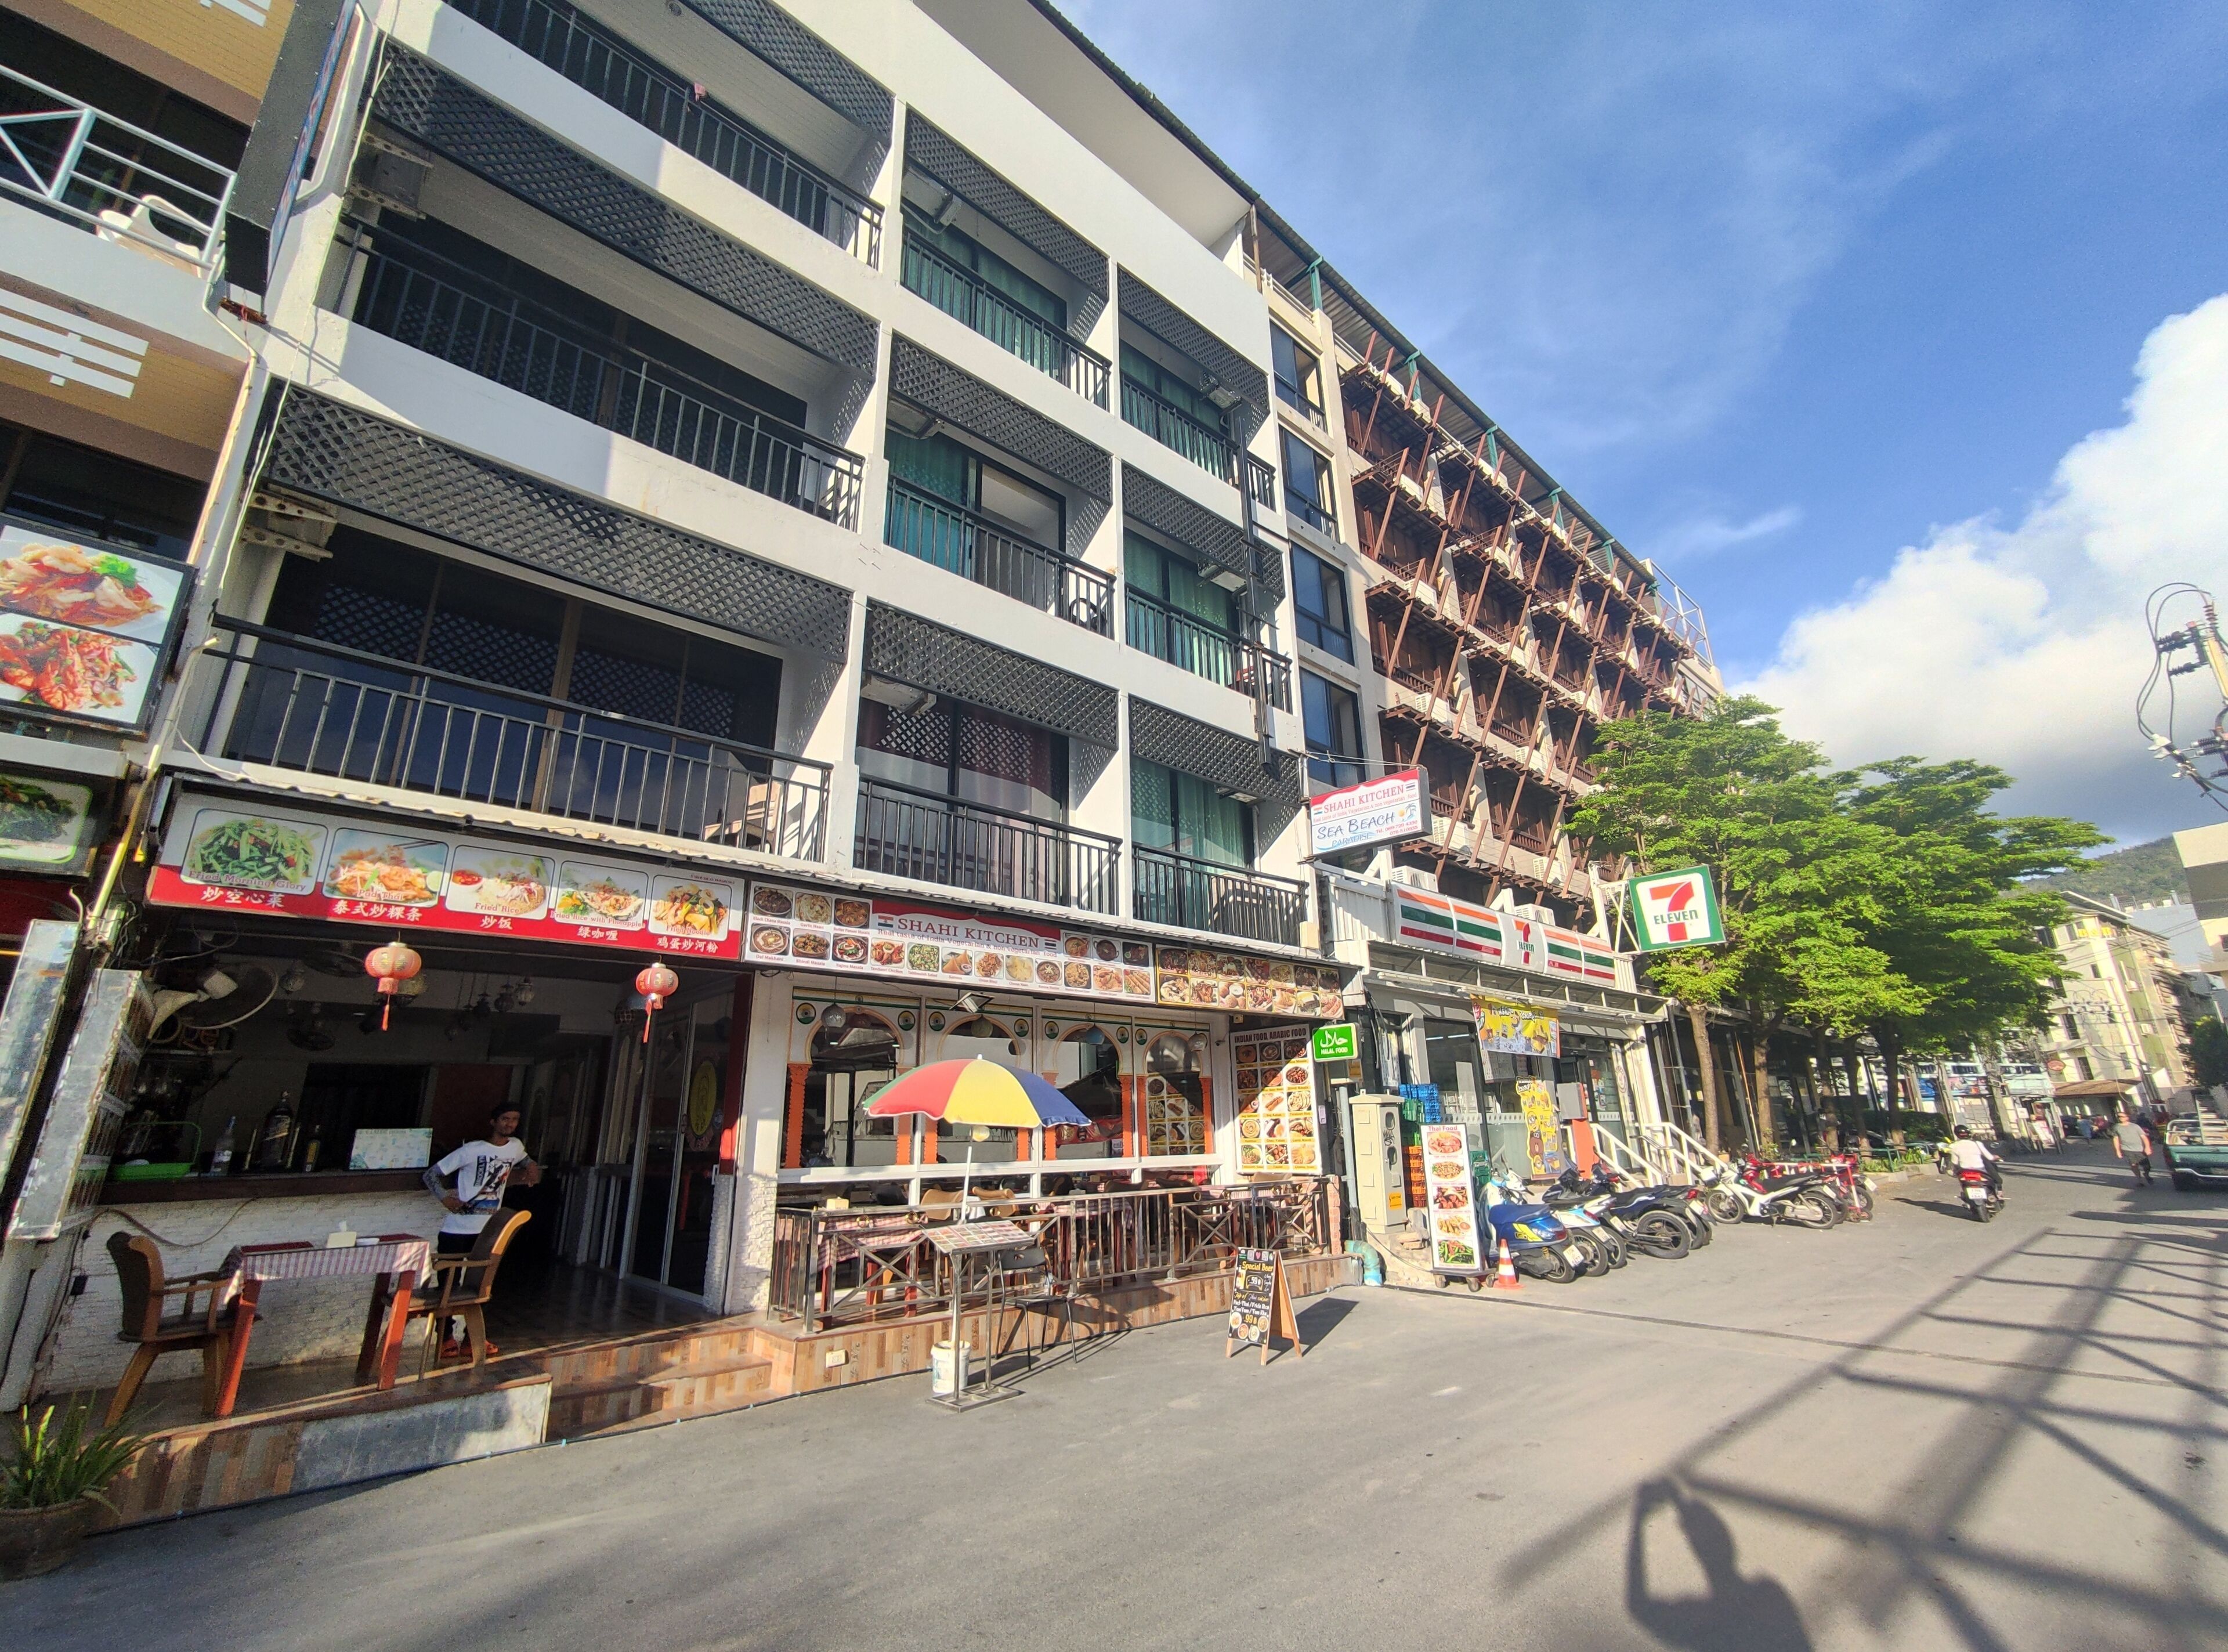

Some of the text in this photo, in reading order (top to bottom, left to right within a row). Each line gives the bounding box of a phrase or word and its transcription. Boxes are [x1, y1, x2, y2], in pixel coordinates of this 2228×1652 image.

[1323, 785, 1404, 813] SHAHI KITCHEN
[1347, 812, 1395, 833] BEACH
[189, 872, 306, 891] Fried Morning Glory
[201, 887, 285, 908] 炒空心菜
[358, 889, 403, 901] Pad Thai
[332, 899, 422, 921] 泰式炒粿条
[475, 903, 520, 914] Fried Rice
[550, 910, 570, 919] Fried
[1649, 881, 1694, 942] 7
[480, 915, 513, 930] 炒饭
[666, 925, 710, 936] Fried Noodle
[577, 926, 618, 941] 绿咖喱
[898, 919, 1039, 948] SHAHI KITCHEN
[657, 936, 718, 953] 鸡蛋炒河粉
[896, 931, 915, 939] taste
[916, 932, 925, 941] of
[1007, 946, 1040, 956] vegetarian
[1044, 950, 1057, 958] food
[1234, 1035, 1252, 1043] INDIAN
[1269, 1029, 1290, 1039] ARABIC
[1292, 1028, 1306, 1037] FOOD
[1320, 1030, 1348, 1047] حلال
[1242, 1261, 1260, 1272] Special
